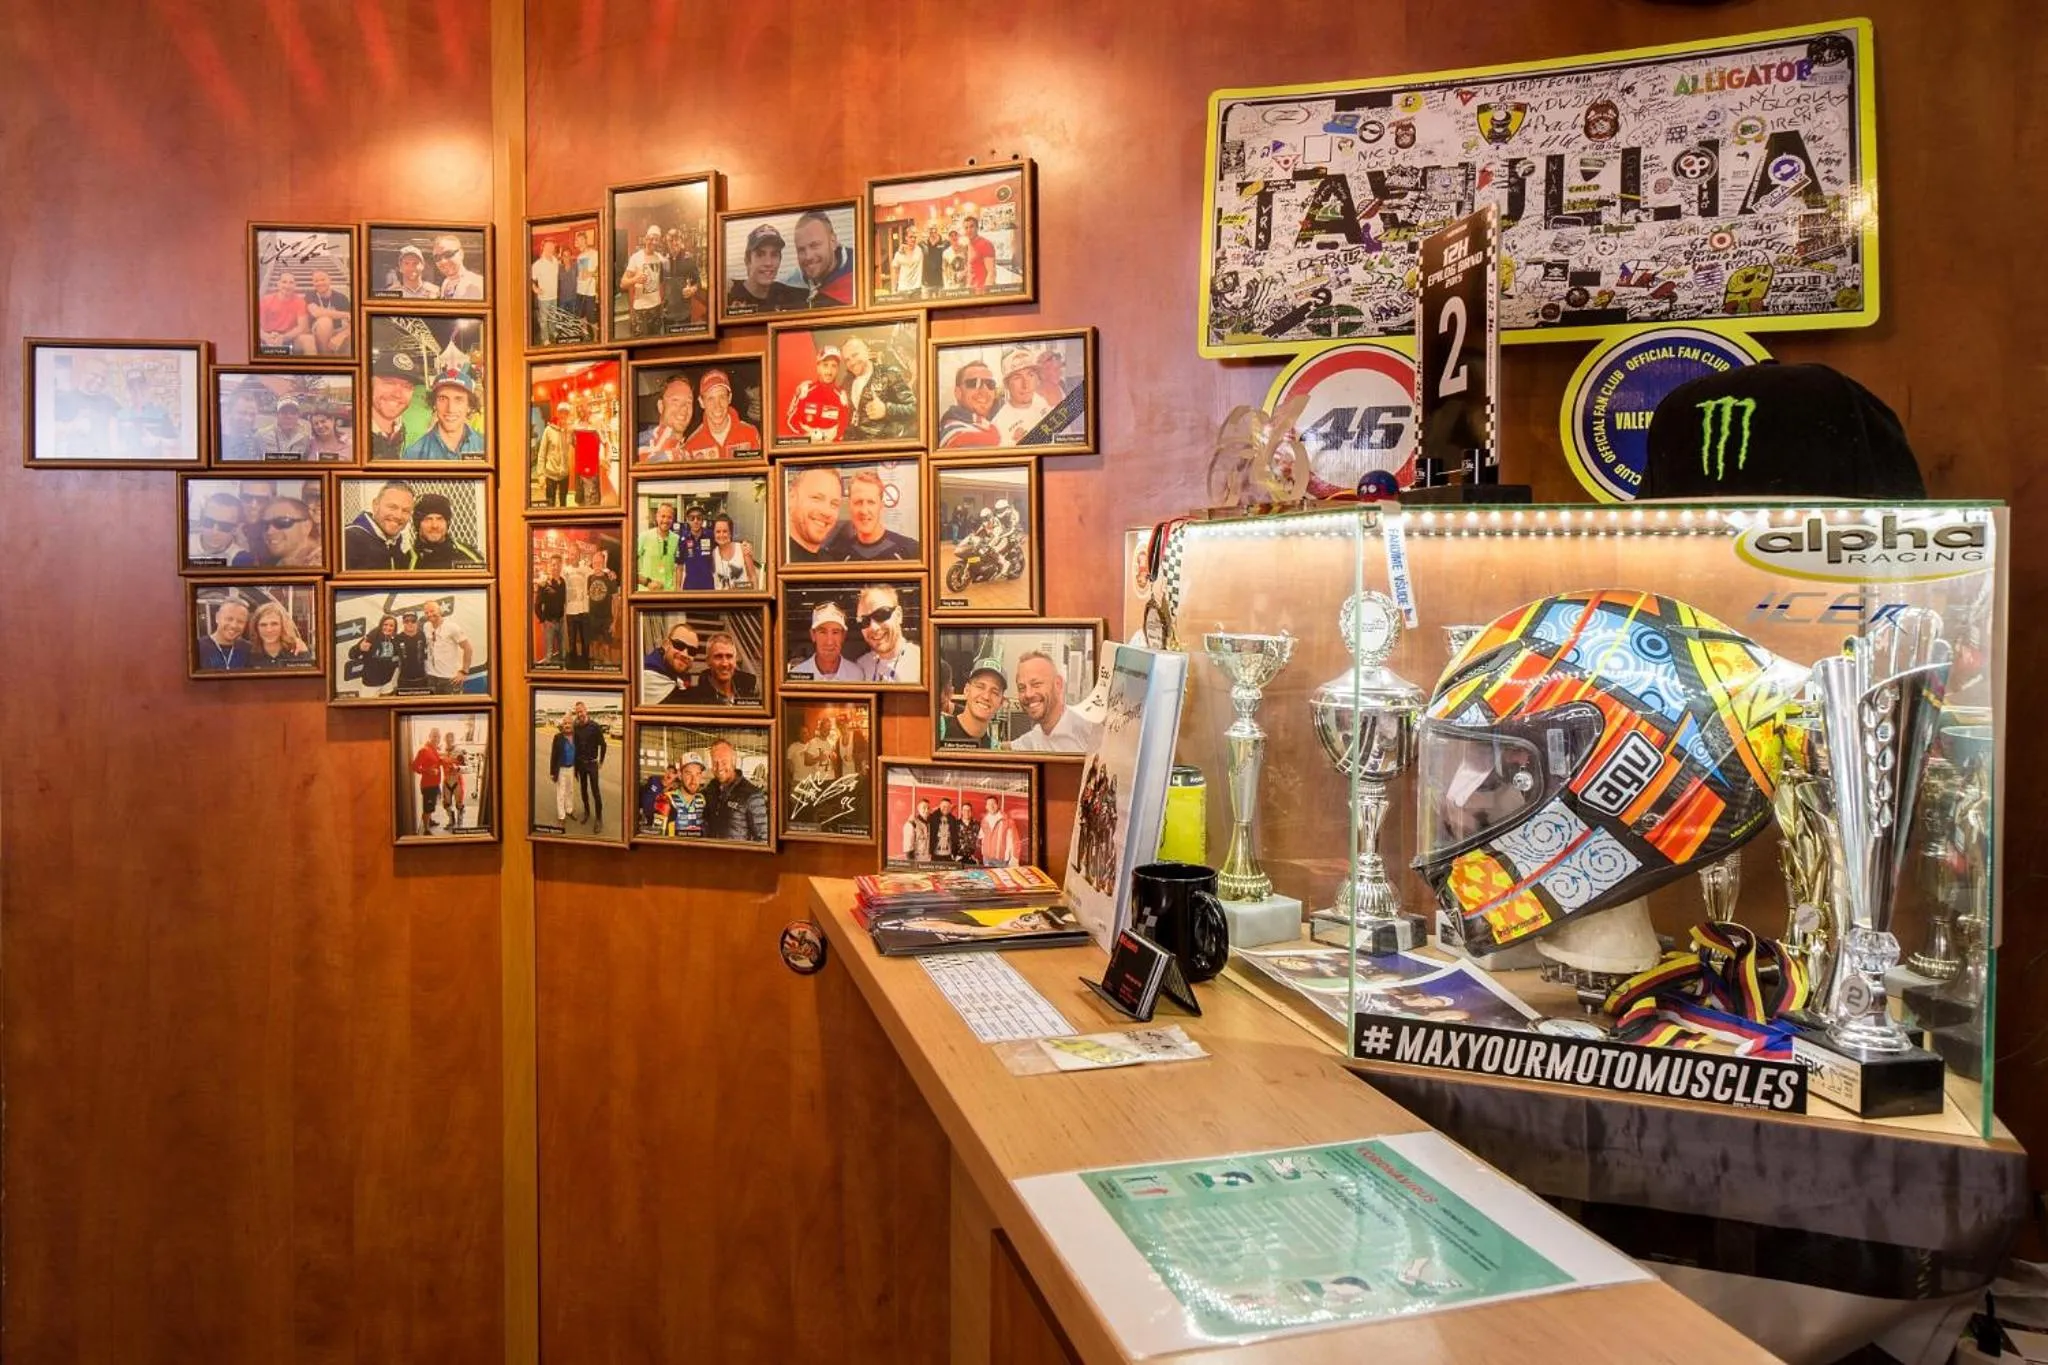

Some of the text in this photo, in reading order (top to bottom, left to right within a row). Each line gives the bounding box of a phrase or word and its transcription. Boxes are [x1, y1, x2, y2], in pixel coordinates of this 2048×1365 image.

[1673, 57, 1813, 96] ALLIGATOR
[1442, 237, 1470, 267] 12H
[1457, 251, 1483, 273] BRNO
[1438, 295, 1468, 398] 2
[1625, 346, 1731, 372] OFFICIAL FAN CLUB
[1299, 405, 1413, 451] 46
[1592, 369, 1626, 464] OFFICIAL FAN CLUB
[1612, 462, 1643, 486] CLUB
[1754, 515, 1989, 564] alpha
[1848, 551, 1985, 564] RACING
[1596, 742, 1652, 807] agv
[1846, 986, 1864, 1007] 2
[1361, 1025, 1799, 1110] #MAXYOURMOTOMUSCLES
[1794, 1053, 1825, 1080] SBK
